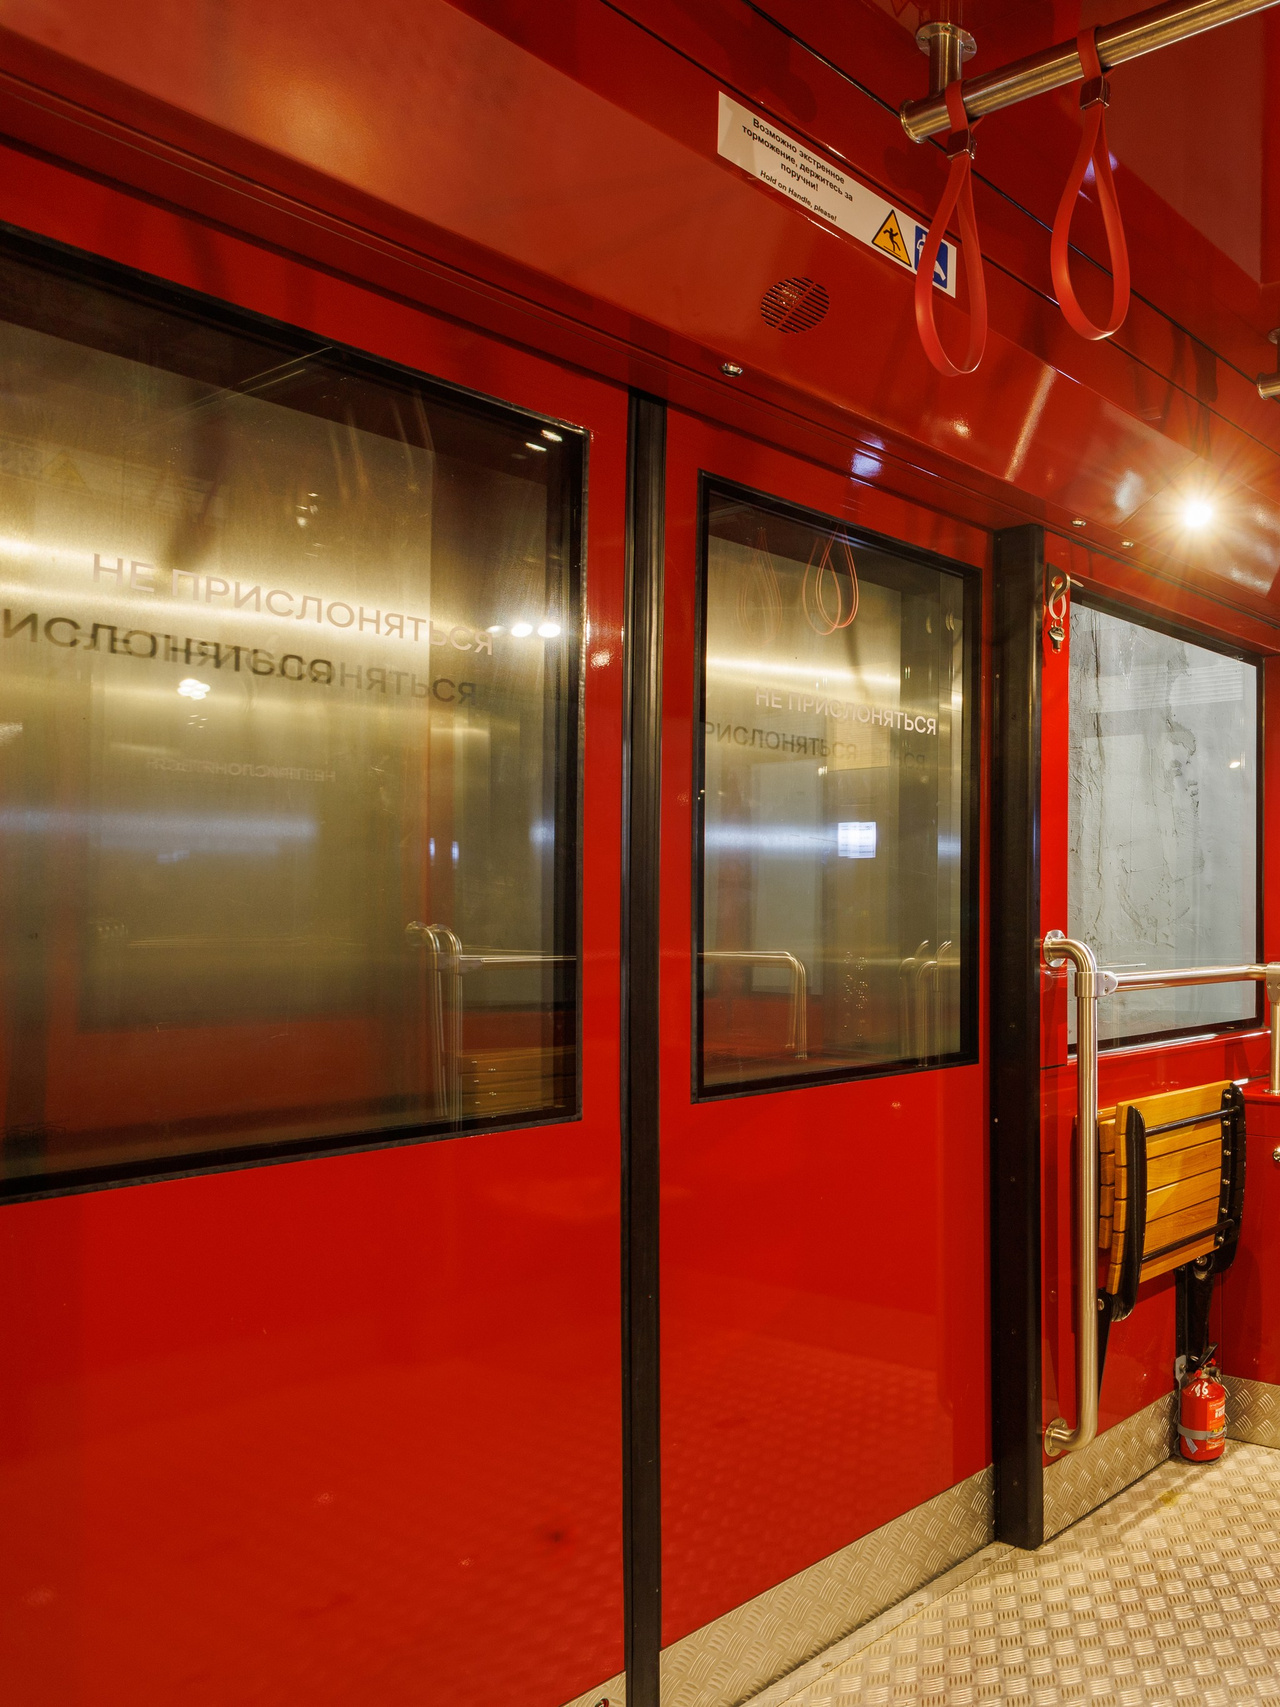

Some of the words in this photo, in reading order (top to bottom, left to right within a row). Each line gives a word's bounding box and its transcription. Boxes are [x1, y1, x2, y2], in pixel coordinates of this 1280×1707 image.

[742, 125, 798, 167] торможение,
[799, 163, 843, 195] держитесь
[844, 191, 853, 202] за
[752, 118, 797, 153] Возможно
[799, 150, 845, 184] экстренное
[780, 163, 819, 191] поручни!
[760, 170, 777, 185] Hold
[778, 182, 787, 191] on
[788, 187, 812, 208] Handle,
[814, 204, 837, 222] please!
[92, 553, 156, 594] НЕ
[171, 568, 494, 656] ПРИСЛОНЯТЬСЯ
[755, 687, 782, 709] НЕ
[788, 692, 936, 735] ПРИСЛОНЯТЬСЯ
